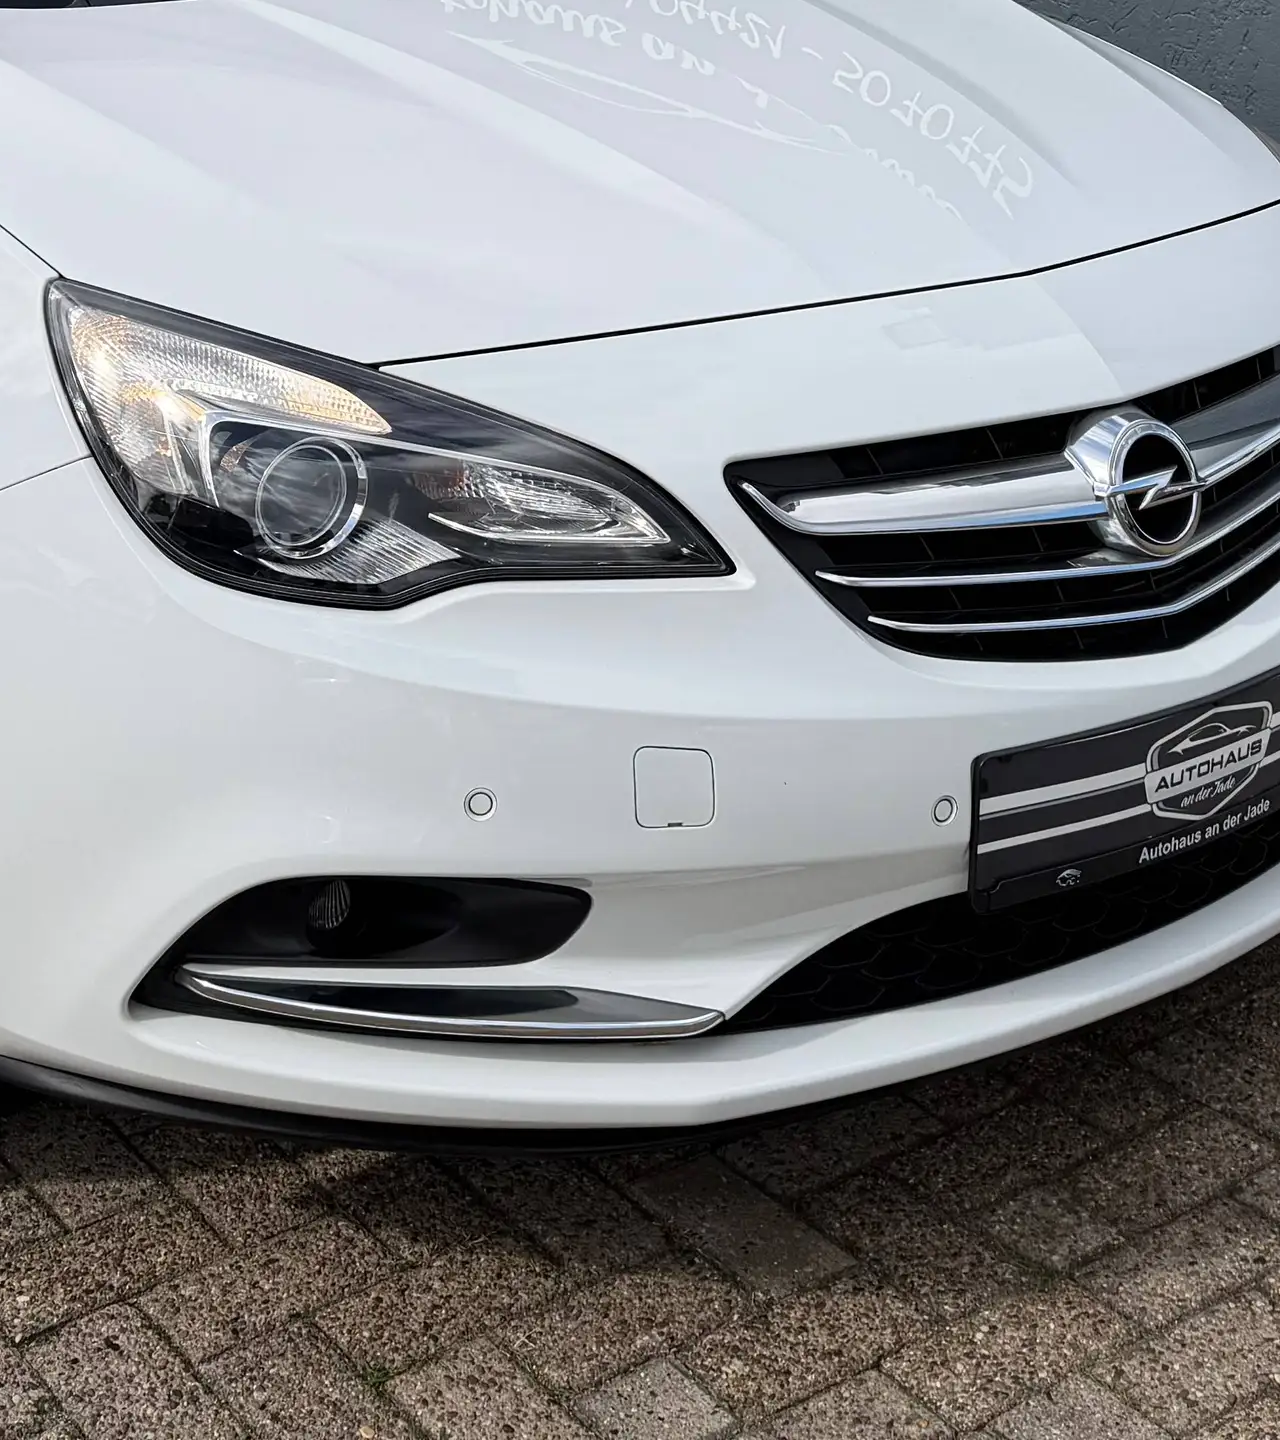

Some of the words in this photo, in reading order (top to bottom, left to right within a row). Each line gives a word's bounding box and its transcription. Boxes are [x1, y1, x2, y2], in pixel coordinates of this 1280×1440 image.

[1154, 738, 1263, 794] AUTOHAUS
[1180, 793, 1195, 808] an
[1195, 785, 1213, 803] der
[1210, 774, 1237, 798] Jade
[1138, 830, 1202, 864] Autohaus
[1204, 823, 1220, 839] an
[1222, 812, 1242, 831] der
[1243, 798, 1271, 822] Jade
